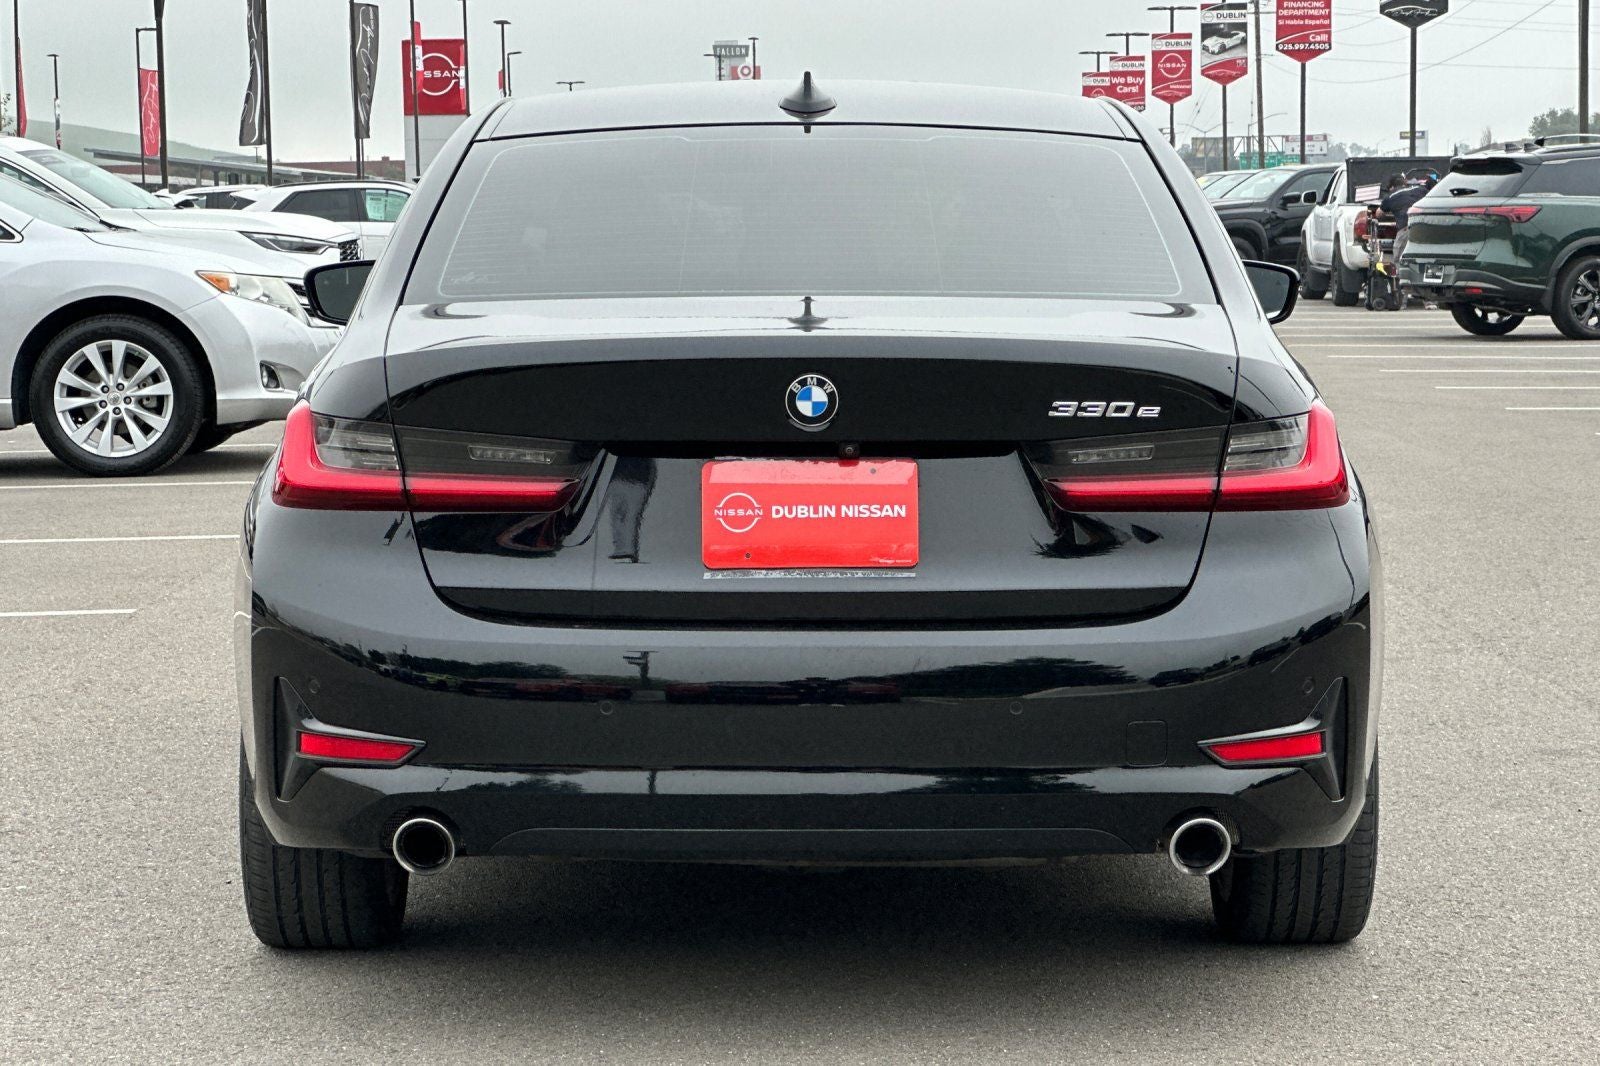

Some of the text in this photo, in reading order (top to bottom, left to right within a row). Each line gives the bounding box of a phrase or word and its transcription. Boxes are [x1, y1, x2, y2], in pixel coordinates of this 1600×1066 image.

[1310, 34, 1329, 42] Call!
[1111, 76, 1145, 85] We Buy
[1116, 85, 1139, 93] Cars!
[791, 377, 834, 393] BMW
[1048, 401, 1161, 417] 330e
[714, 508, 763, 516] NISSAN
[771, 504, 906, 519] DUBLIN NISSAN
